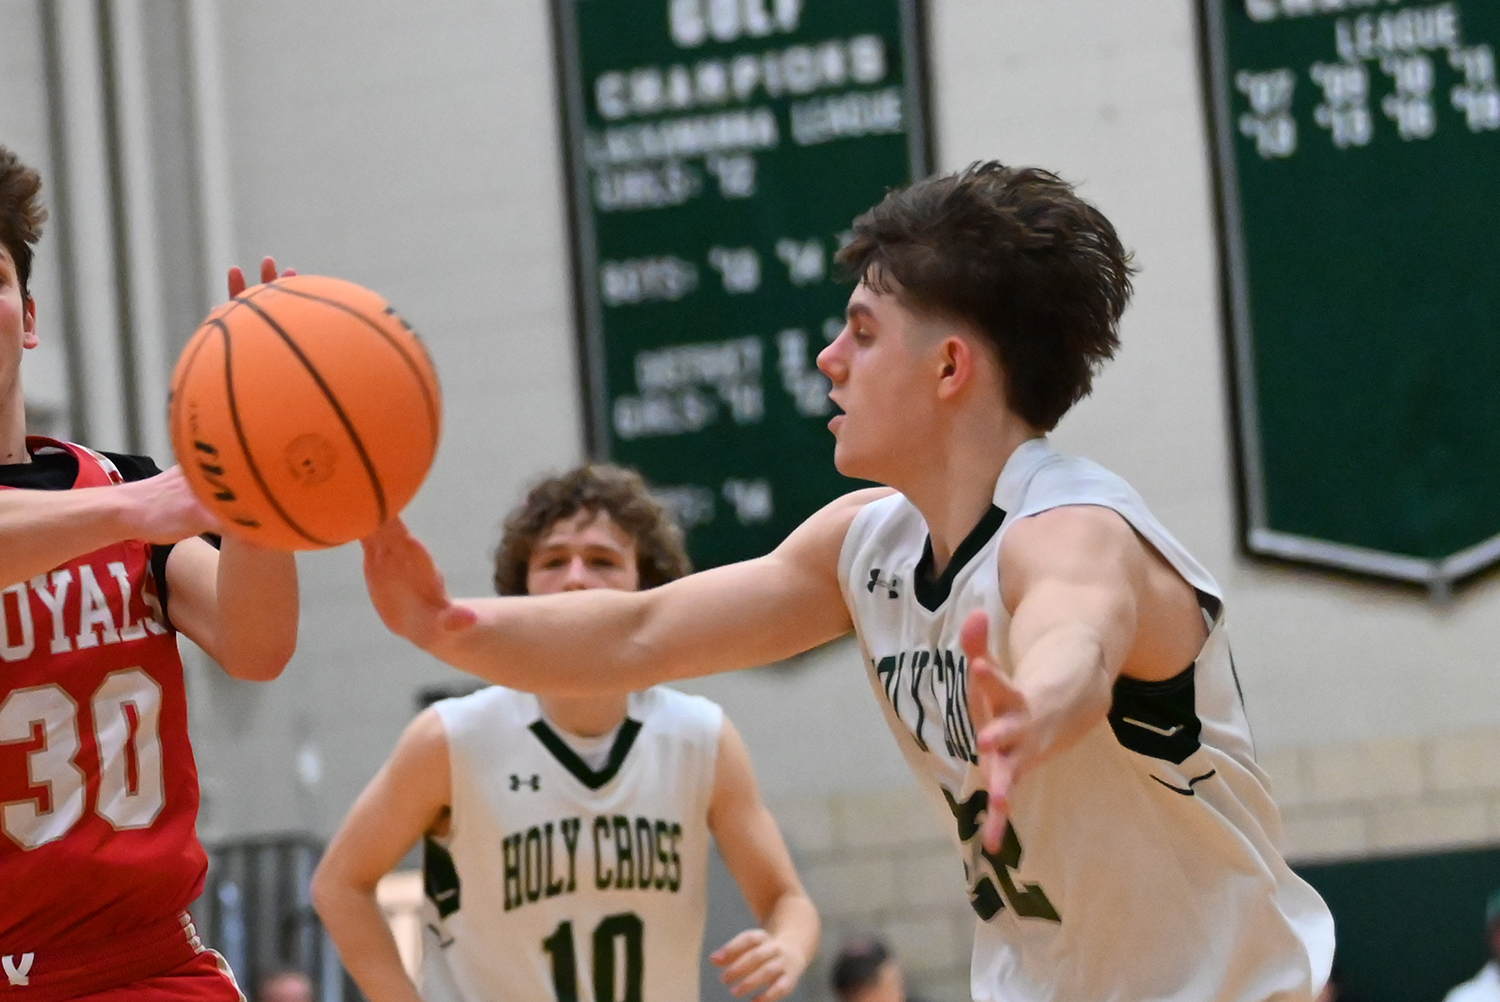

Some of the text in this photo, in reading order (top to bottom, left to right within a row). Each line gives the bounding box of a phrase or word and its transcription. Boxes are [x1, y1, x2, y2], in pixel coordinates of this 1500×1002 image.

[1335, 3, 1458, 61] LEAGUE
[599, 35, 886, 119] CHAMPIONS
[790, 88, 902, 145] LEAGUE
[502, 815, 683, 912] HOLY CROSS
